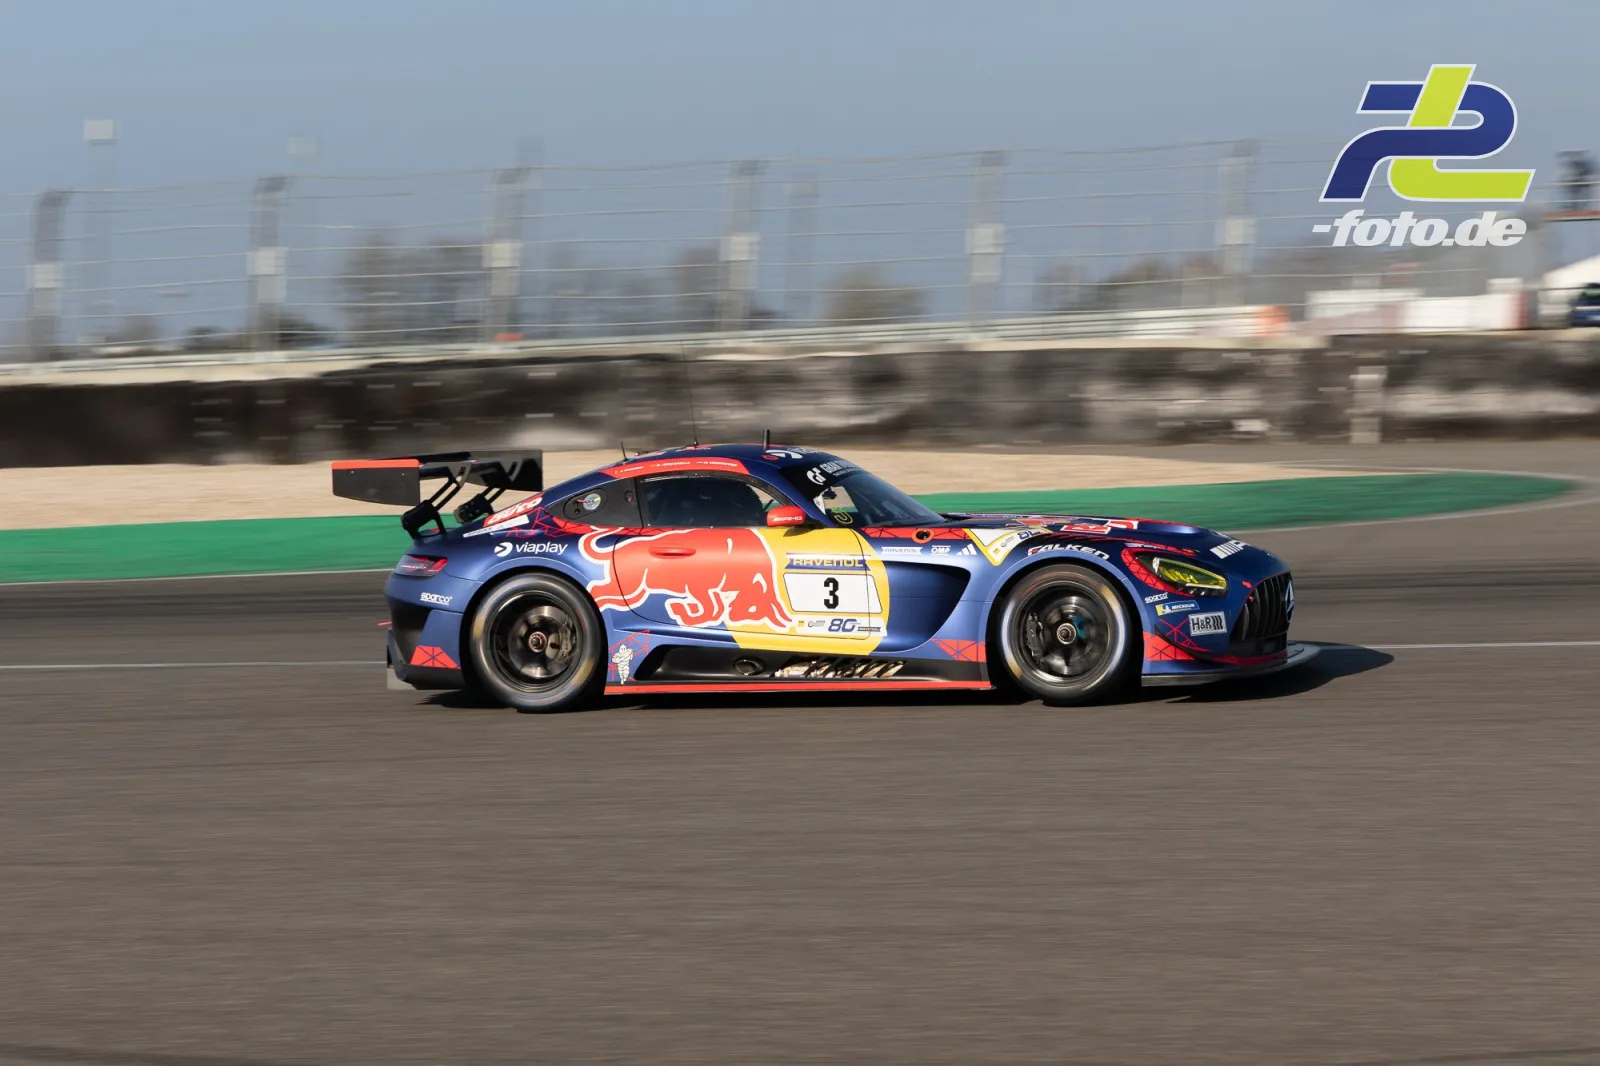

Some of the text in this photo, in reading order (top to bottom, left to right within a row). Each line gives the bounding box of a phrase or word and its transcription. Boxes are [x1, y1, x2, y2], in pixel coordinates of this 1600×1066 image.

[515, 541, 568, 556] viaplay
[1027, 543, 1110, 560] FALKEN
[792, 558, 864, 568] RAVENOL
[420, 591, 453, 605] sparco
[823, 577, 839, 610] 3
